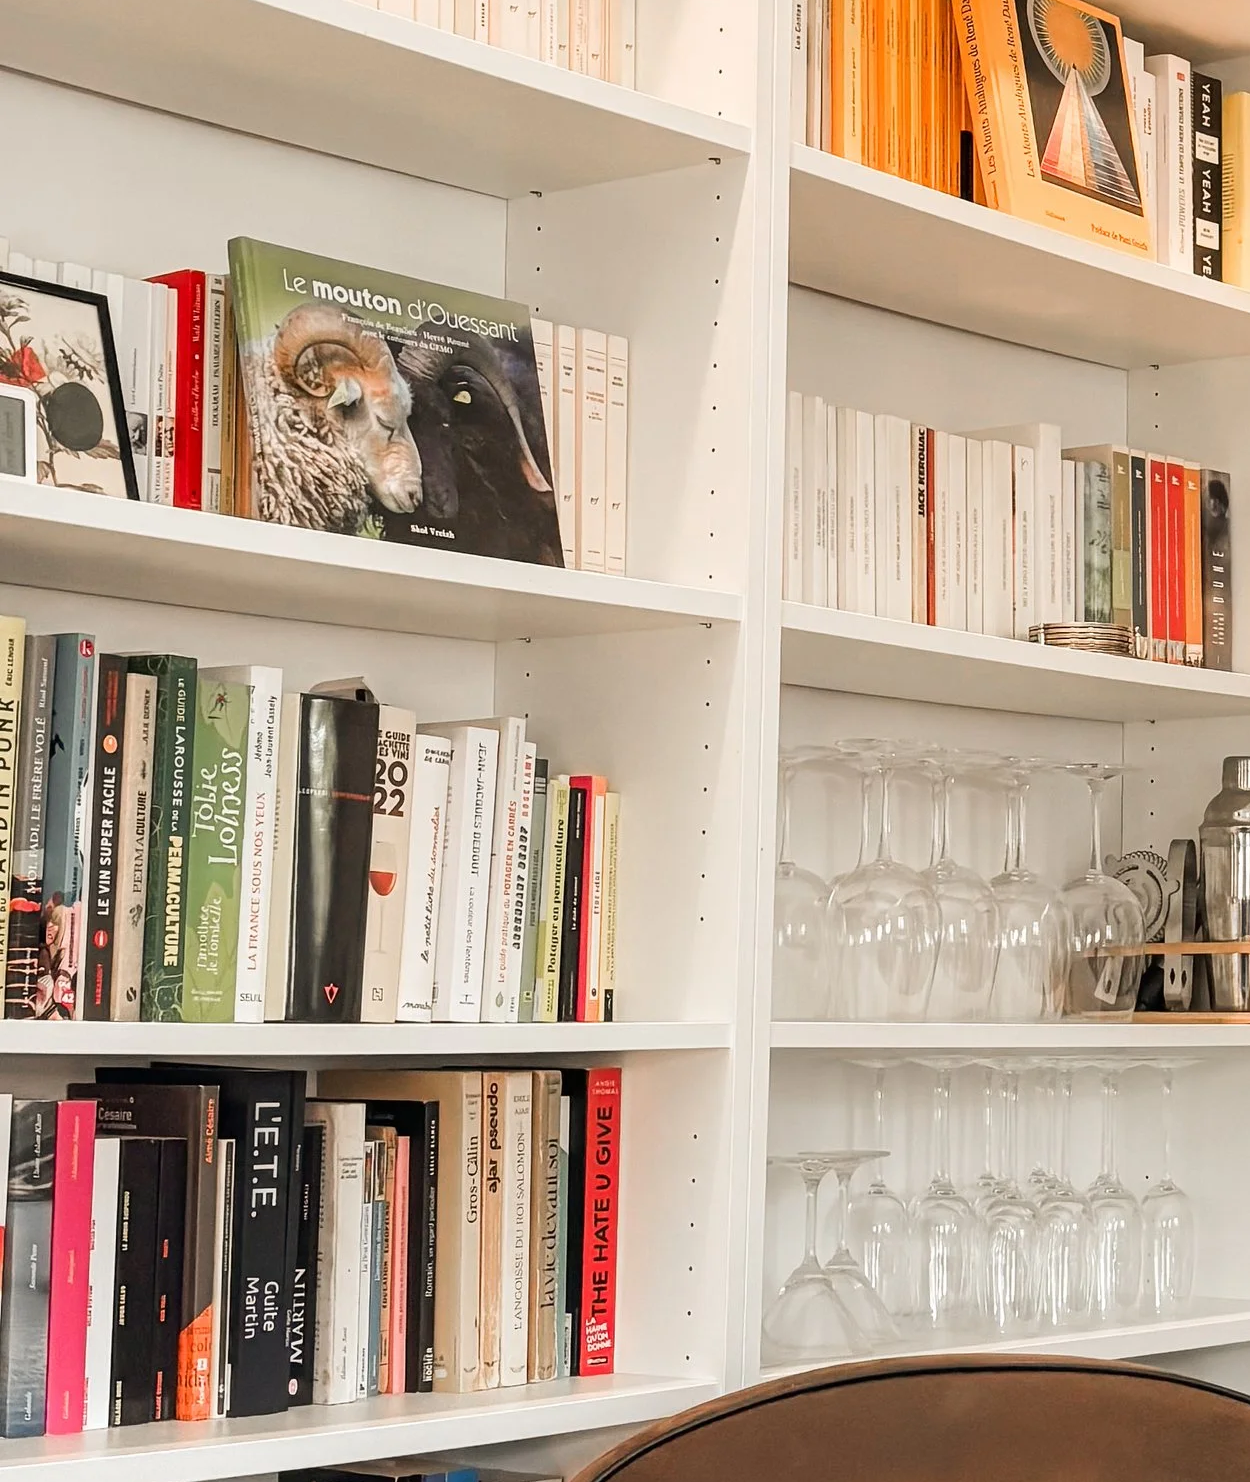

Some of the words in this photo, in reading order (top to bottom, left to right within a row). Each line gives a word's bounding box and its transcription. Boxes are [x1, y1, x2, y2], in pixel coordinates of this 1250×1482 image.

[964, 14, 977, 43] René
[1004, 19, 1015, 47] René
[969, 44, 978, 57] de
[1010, 49, 1018, 62] de
[972, 58, 989, 115] Analogues
[1012, 63, 1027, 121] Analogues
[1202, 83, 1211, 127] YEAH
[981, 118, 994, 154] Monts
[986, 155, 997, 175] Les
[1025, 160, 1036, 179] Les
[1202, 169, 1211, 213] YEAH
[282, 268, 308, 295] Le
[312, 278, 402, 316] mouton
[408, 298, 520, 342] d'Ouessant
[918, 427, 926, 485] KEROUAC
[918, 487, 926, 518] JACK
[1212, 550, 1225, 603] DUNE
[177, 678, 184, 688] LE
[176, 689, 186, 722] GUIDE
[266, 694, 278, 724] Cassely
[385, 731, 411, 742] GUIDE
[171, 726, 187, 807] LAROUSSE
[376, 758, 408, 787] 20
[101, 766, 117, 816] FACILE
[193, 765, 219, 837] Tobie
[373, 788, 405, 817] 22
[473, 742, 487, 830] JEAN-JACQUES
[206, 747, 243, 866] Lolness
[255, 791, 267, 827] YEUX
[506, 799, 517, 837] CARRÉS
[99, 818, 114, 866] SUPER
[171, 822, 179, 832] LA
[252, 831, 264, 857] NOS
[505, 839, 514, 852] EN
[551, 818, 565, 905] permaculture
[97, 870, 111, 895] VIN
[250, 860, 262, 894] SOUS
[503, 854, 514, 896] POTAGER
[96, 899, 110, 916] LE
[163, 836, 183, 967] PERMACULTURE
[466, 898, 476, 927] couleur
[503, 897, 510, 909] du
[551, 907, 560, 922] en
[248, 897, 261, 950] FRANCE
[465, 929, 473, 944] des
[500, 911, 511, 946] pratique
[247, 953, 257, 970] LA
[463, 946, 473, 984] fantômes
[499, 948, 509, 971] guide
[547, 924, 559, 974] Potager
[487, 1082, 501, 1151] pseudo
[594, 1106, 613, 1165] GIVE
[250, 1100, 283, 1219] L'E.T.E.
[486, 1158, 501, 1193] ajar
[514, 1132, 525, 1200] SALOMON
[465, 1135, 480, 1224] Gros-Câlin
[594, 1174, 612, 1190] U
[514, 1201, 524, 1224] ROI
[593, 1197, 612, 1262] HATE
[514, 1228, 524, 1248] DU
[262, 1280, 280, 1333] Guite
[513, 1250, 524, 1330] L'ANGOISSE
[591, 1270, 611, 1318] THE
[243, 1277, 261, 1340] Martin
